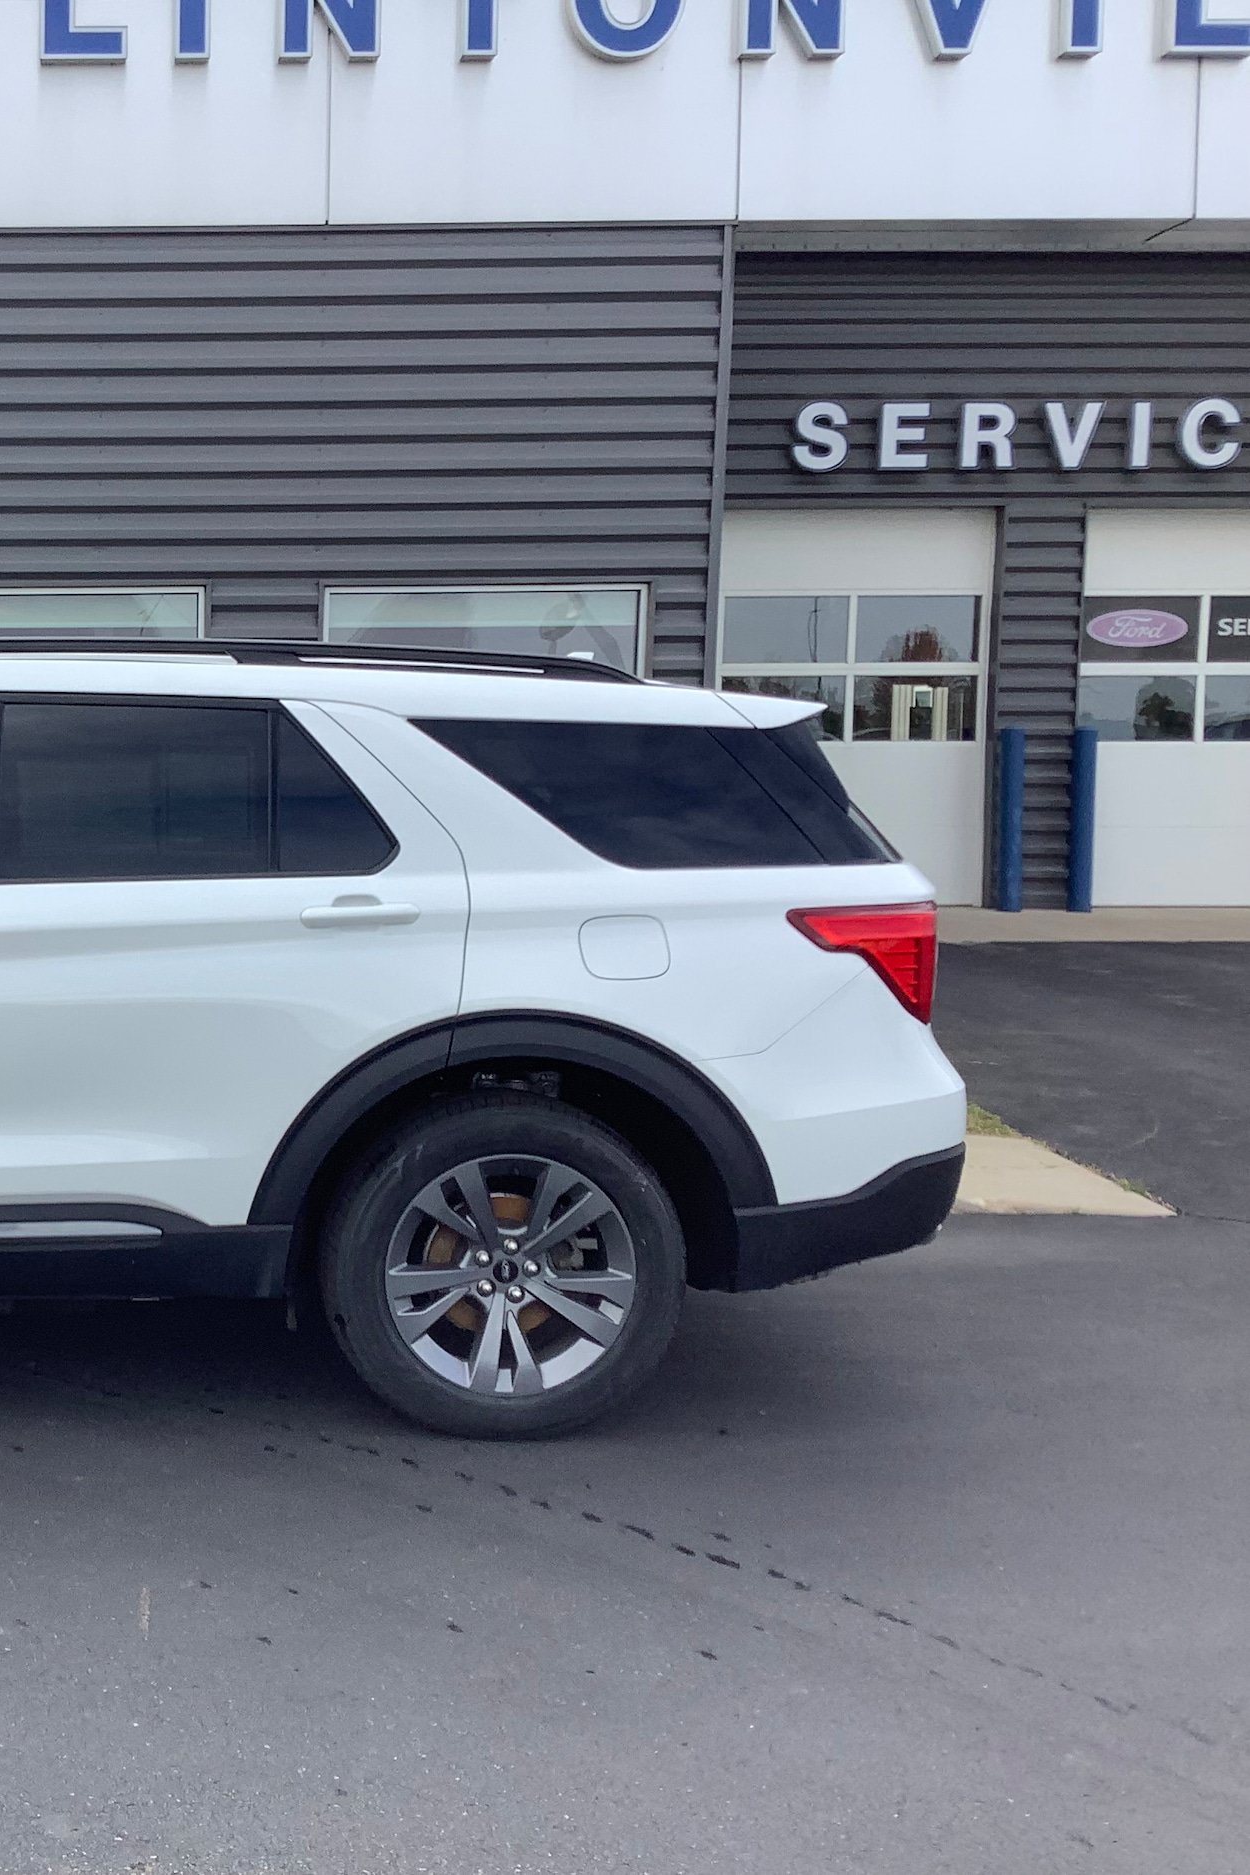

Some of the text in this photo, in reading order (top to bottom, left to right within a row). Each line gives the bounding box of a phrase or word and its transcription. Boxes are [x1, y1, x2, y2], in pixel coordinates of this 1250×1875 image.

[791, 398, 1242, 473] SERVIC
[1107, 615, 1167, 639] Ford
[1217, 617, 1250, 636] SE
